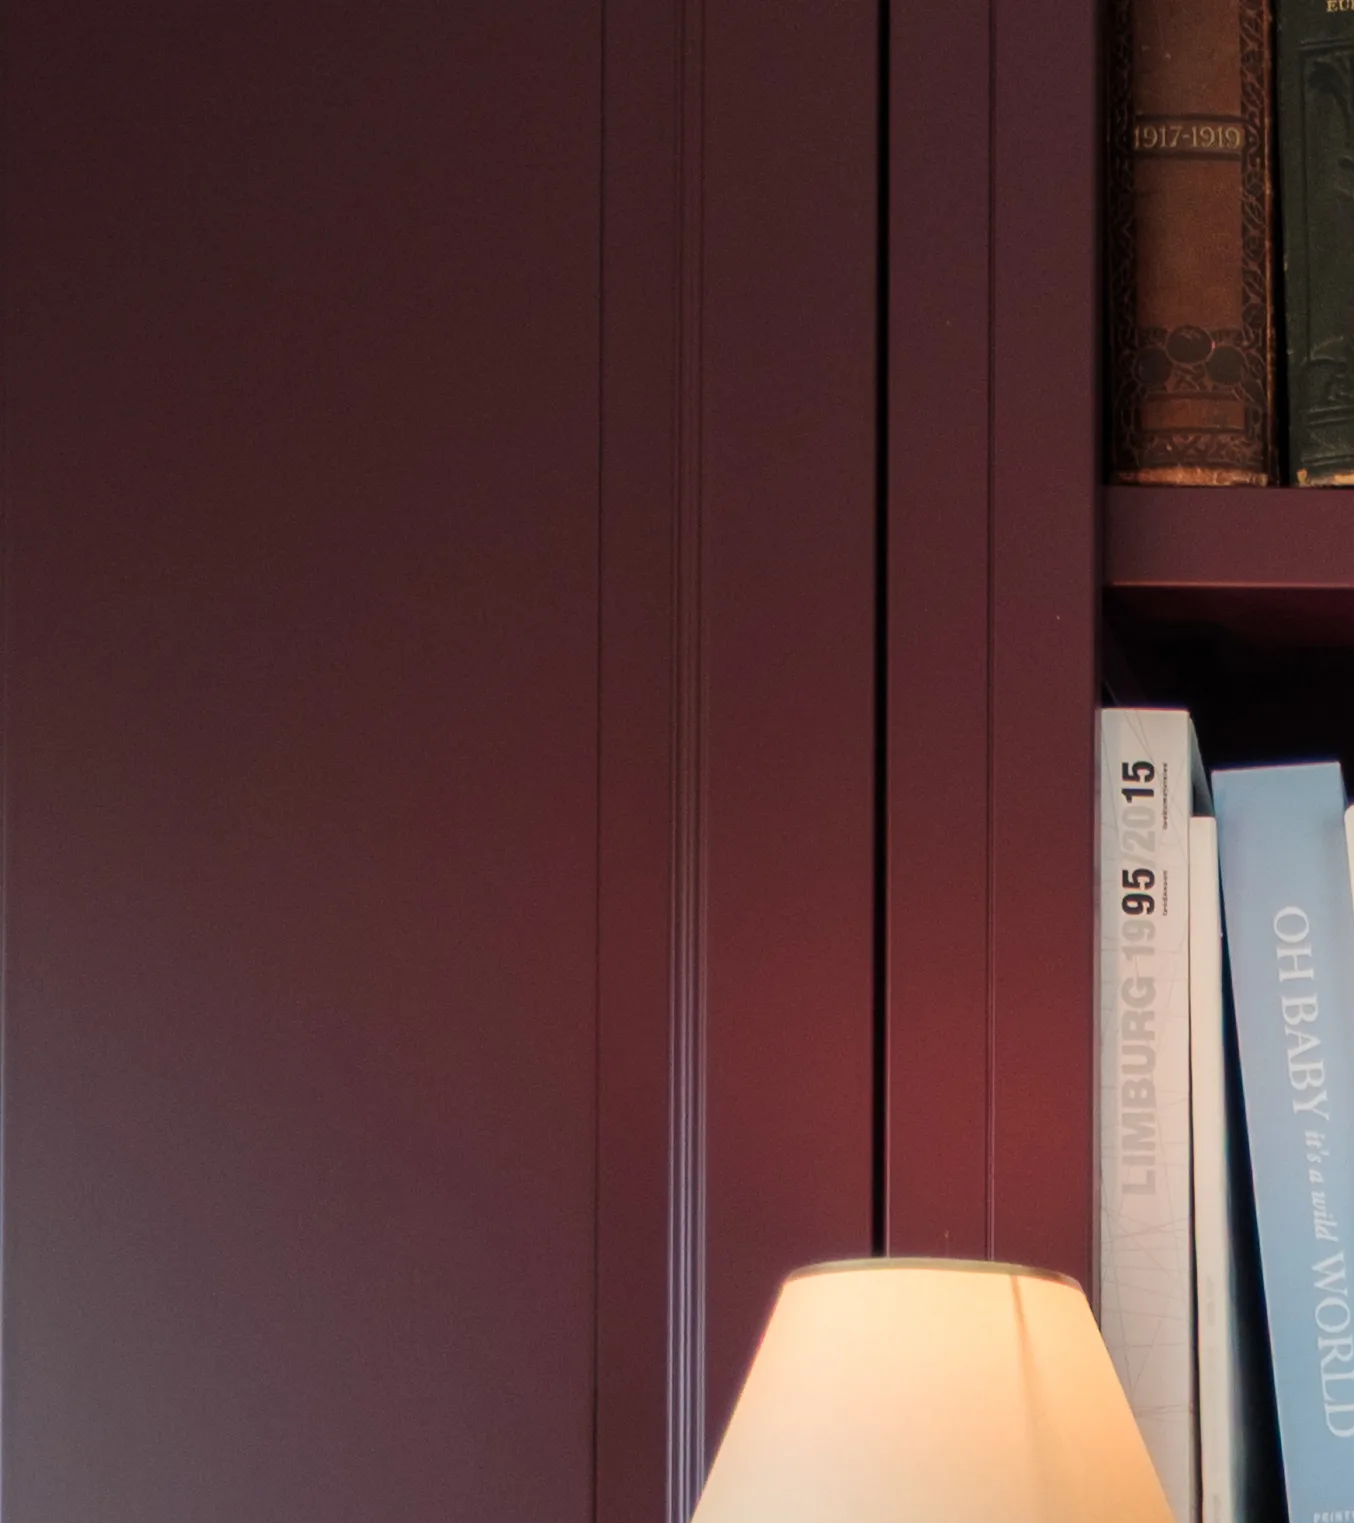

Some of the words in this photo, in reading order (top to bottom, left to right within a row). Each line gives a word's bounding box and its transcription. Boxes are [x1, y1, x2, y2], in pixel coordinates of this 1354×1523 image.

[1134, 126, 1241, 149] 1917-1919
[1121, 761, 1157, 962] 1995/2015
[1273, 906, 1315, 983] OH
[1121, 976, 1156, 1196] LIMBURG
[1281, 992, 1330, 1121] BABY
[1309, 1169, 1325, 1185] a
[1312, 1188, 1339, 1242] wild
